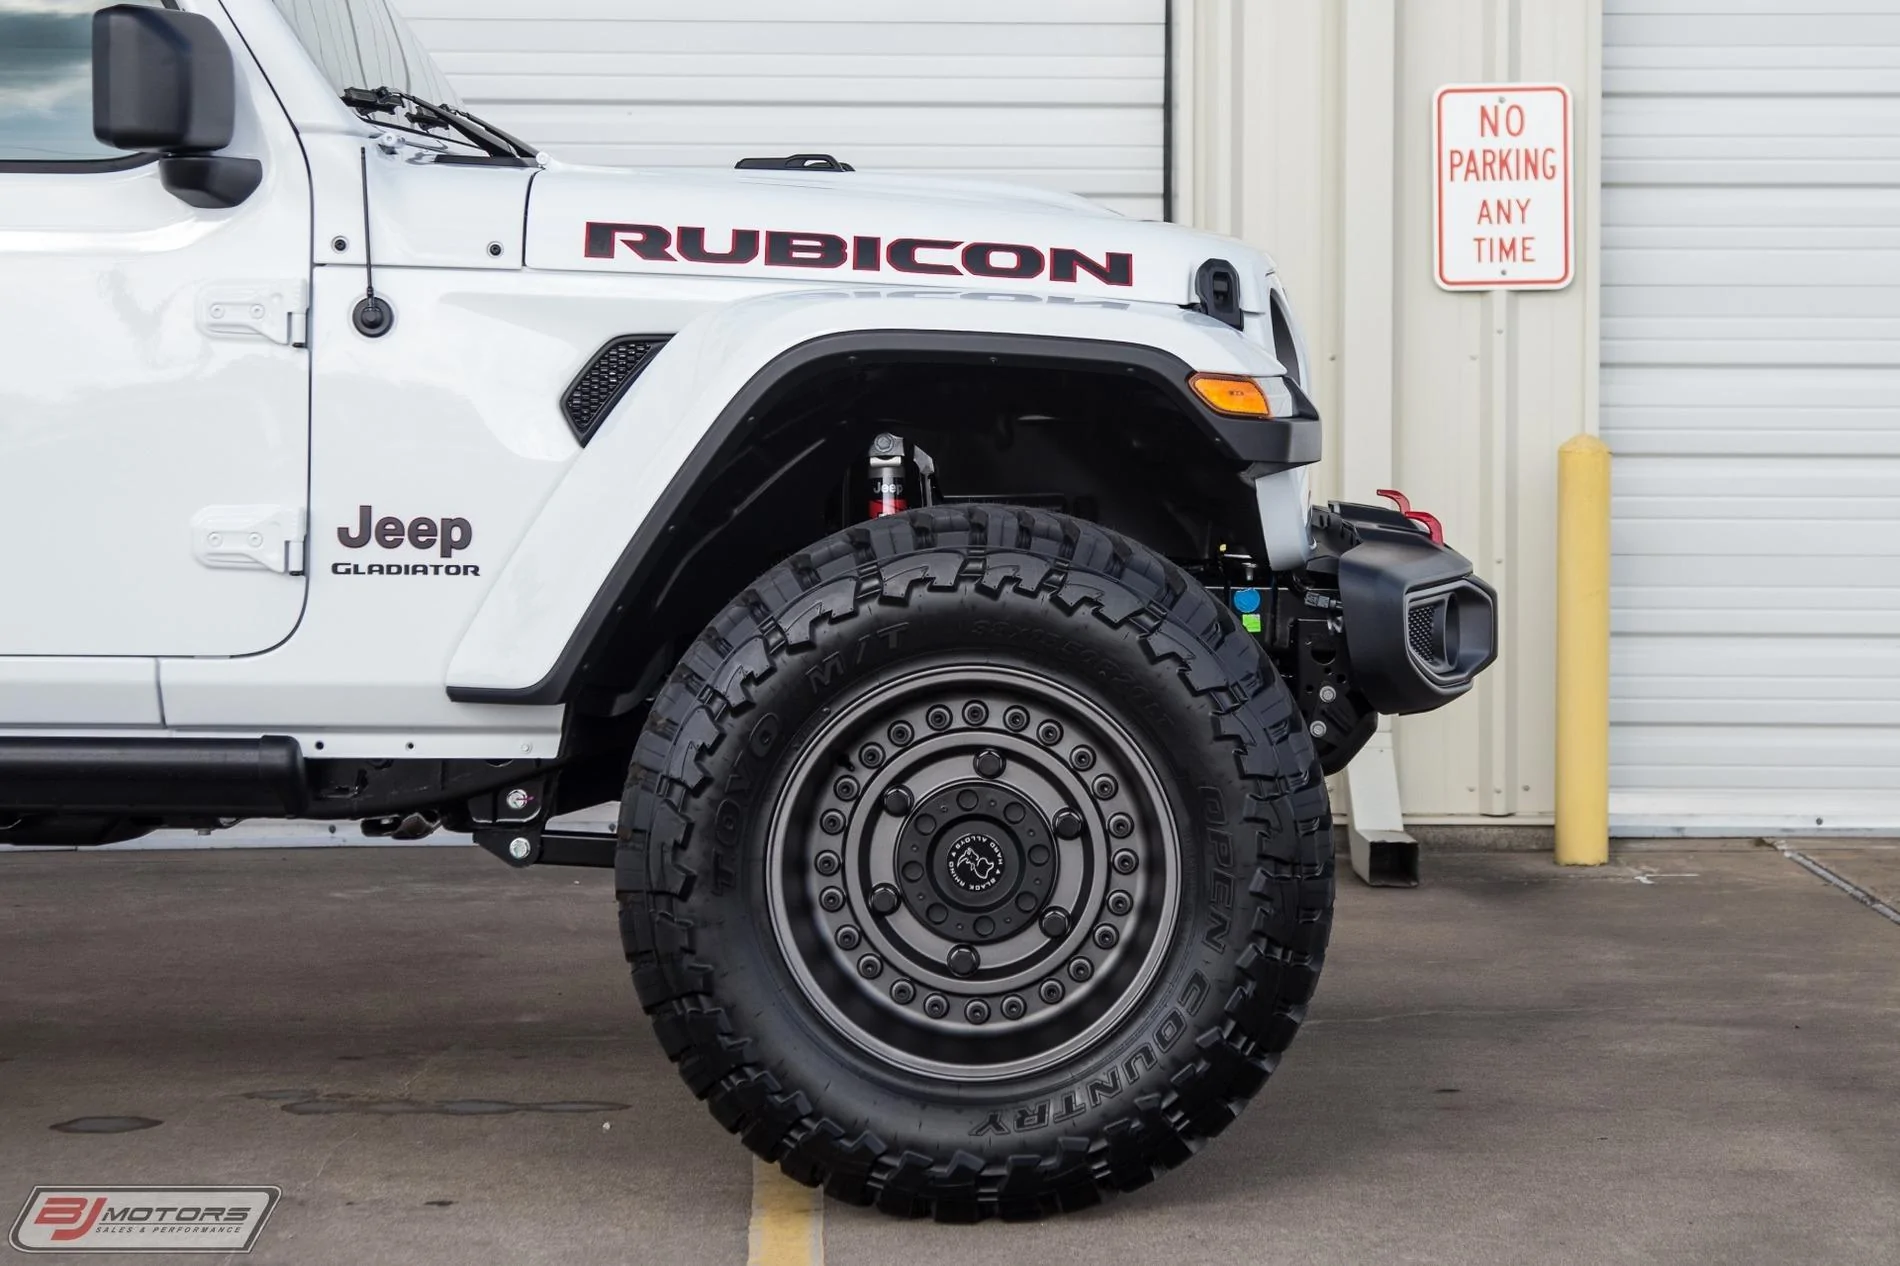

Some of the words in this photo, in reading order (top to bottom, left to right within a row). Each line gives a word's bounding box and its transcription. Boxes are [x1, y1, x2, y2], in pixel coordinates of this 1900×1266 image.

[1480, 104, 1525, 138] NO
[1449, 148, 1557, 182] PARKING
[1477, 198, 1531, 225] ANY
[584, 221, 1133, 287] RUBICON
[1473, 236, 1536, 263] TIME
[873, 481, 903, 495] Jeep
[337, 505, 473, 558] Jeep
[331, 562, 481, 576] GLADIATOR
[710, 712, 780, 896] TOYO
[804, 622, 909, 694] M/T
[955, 835, 988, 850] ALLOYS
[989, 842, 1003, 865] HARD
[948, 861, 966, 887] RHINO
[1197, 785, 1237, 954] OPEN
[969, 877, 996, 891] BLACK
[968, 969, 1211, 1136] COUNTRY
